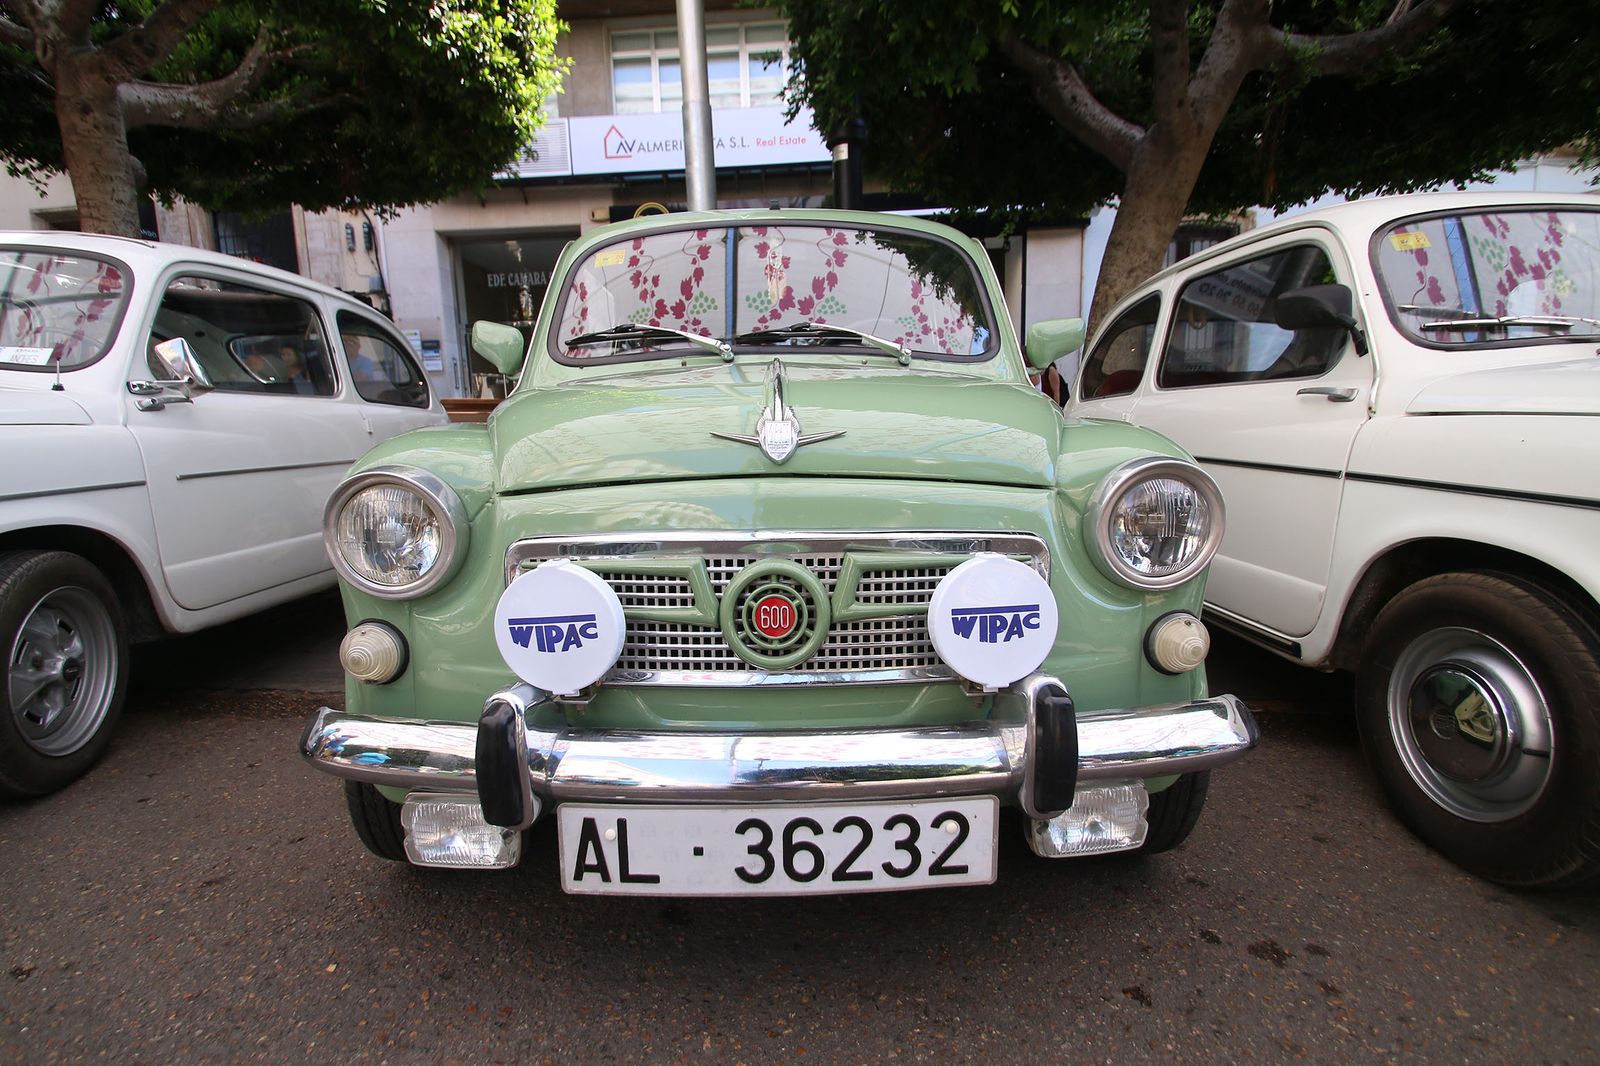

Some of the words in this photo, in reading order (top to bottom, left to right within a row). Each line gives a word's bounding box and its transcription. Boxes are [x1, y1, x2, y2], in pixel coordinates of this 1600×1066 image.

[637, 137, 725, 153] ALMERIA
[729, 136, 750, 149] S.L.
[756, 136, 776, 147] Real
[779, 134, 807, 145] Estate
[760, 605, 790, 629] 600
[951, 612, 1041, 643] WIPAC
[509, 622, 599, 653] WIPAC
[573, 817, 660, 884] AL
[735, 810, 970, 884] 36232
